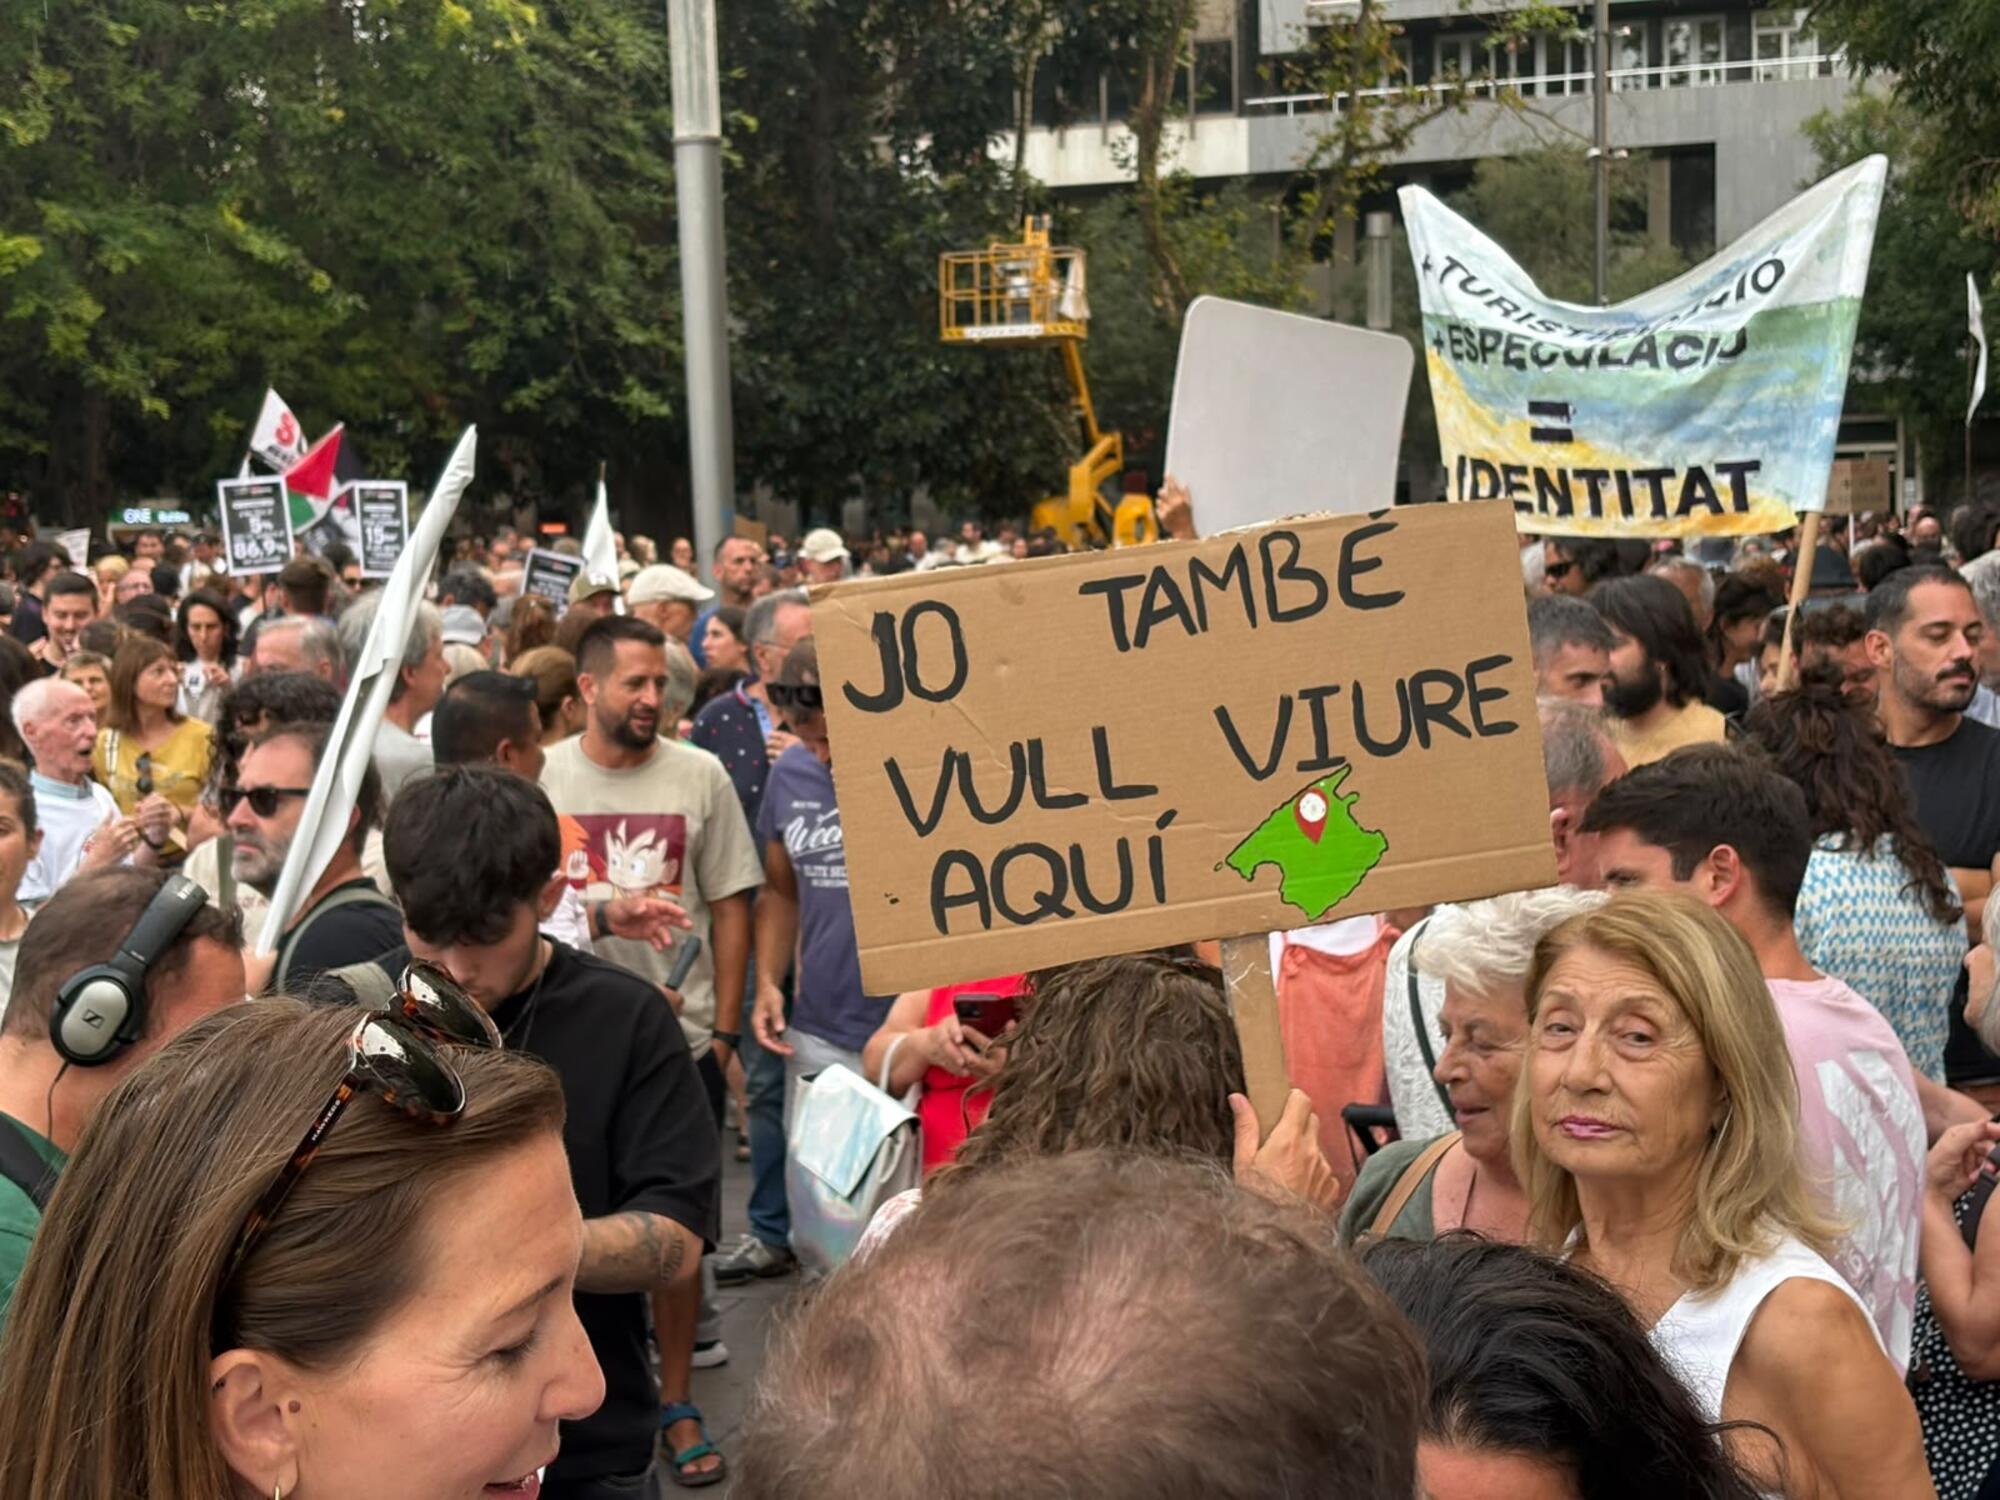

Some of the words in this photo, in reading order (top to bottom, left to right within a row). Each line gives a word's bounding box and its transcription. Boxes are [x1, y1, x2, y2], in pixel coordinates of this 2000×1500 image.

[1457, 455, 1762, 518] IDENTITAT
[843, 601, 969, 712] JO
[1079, 508, 1406, 652] TAMBÉ
[884, 727, 1159, 838] VULL
[1214, 655, 1519, 781] VIURE
[930, 808, 1178, 935] AQUÍ
